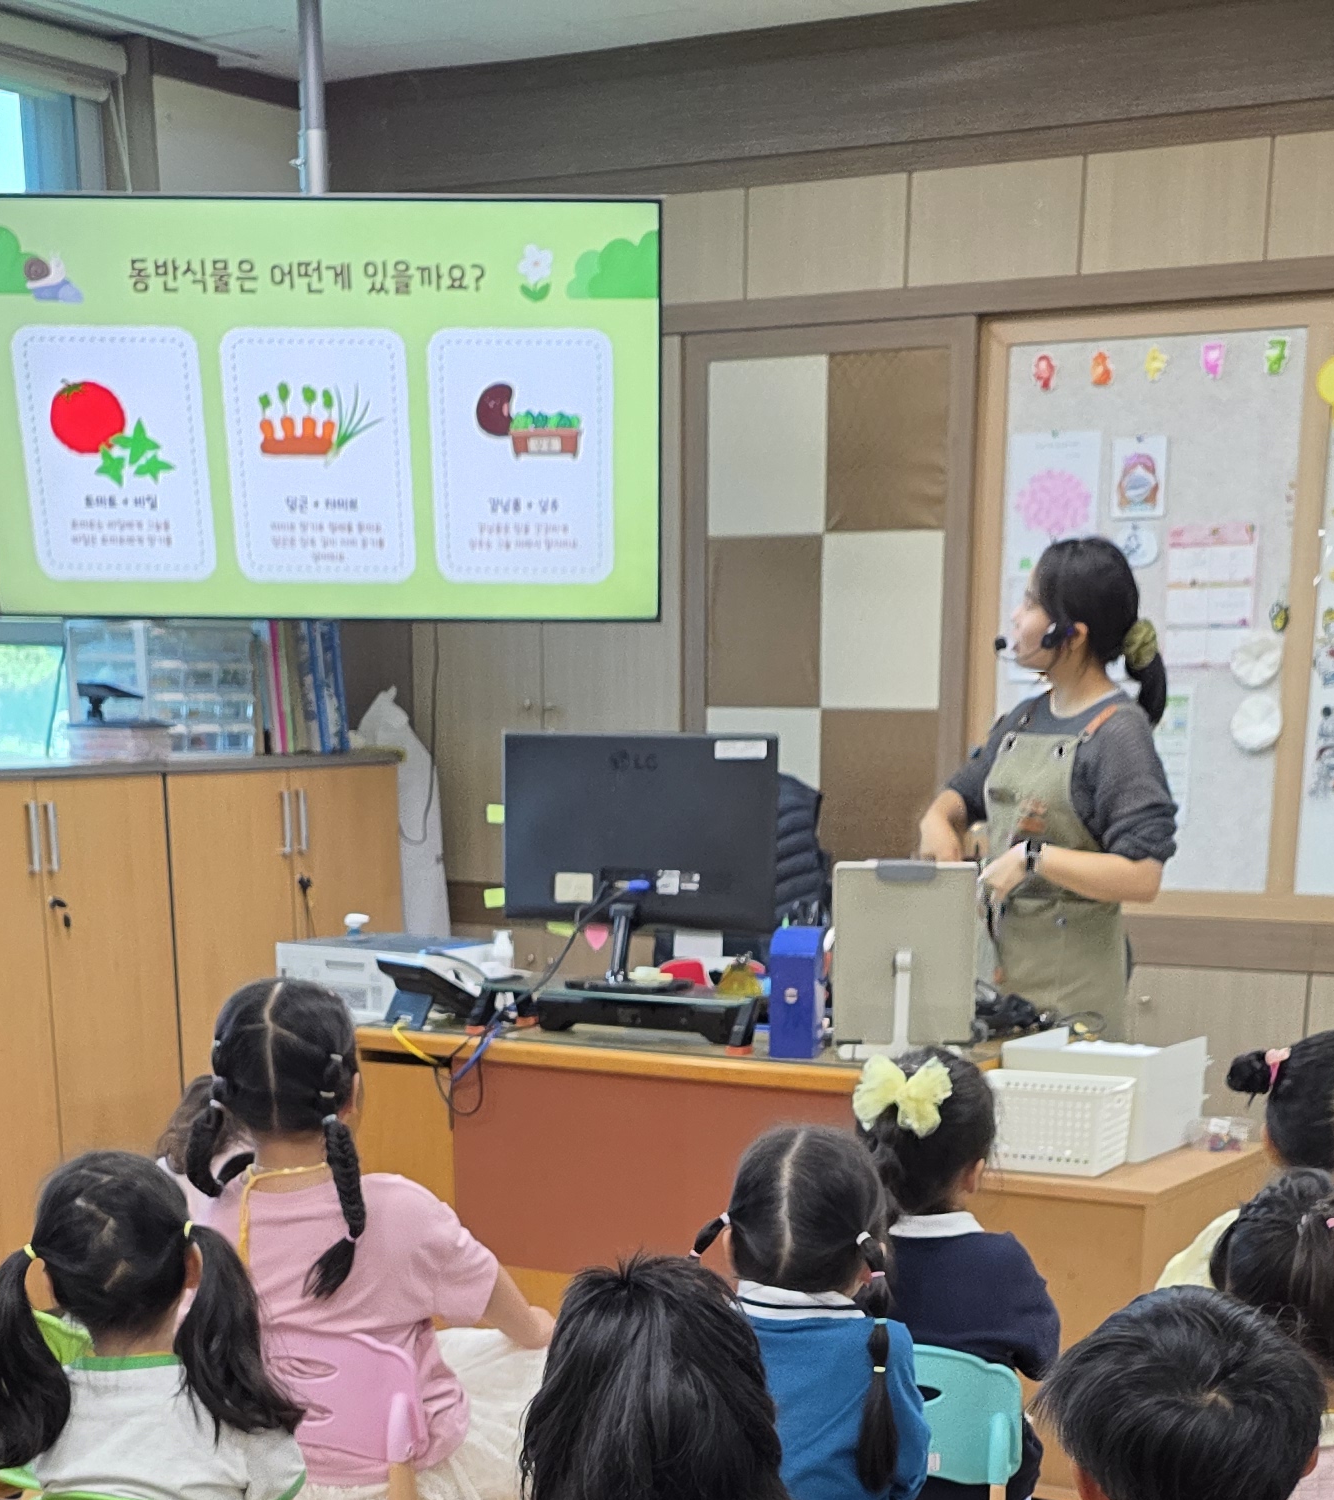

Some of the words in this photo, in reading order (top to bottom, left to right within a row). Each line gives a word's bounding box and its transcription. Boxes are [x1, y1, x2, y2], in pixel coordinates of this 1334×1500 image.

[128, 258, 258, 294] 동반식물은
[270, 259, 352, 294] 어떤게
[363, 259, 486, 295] 있을까요?
